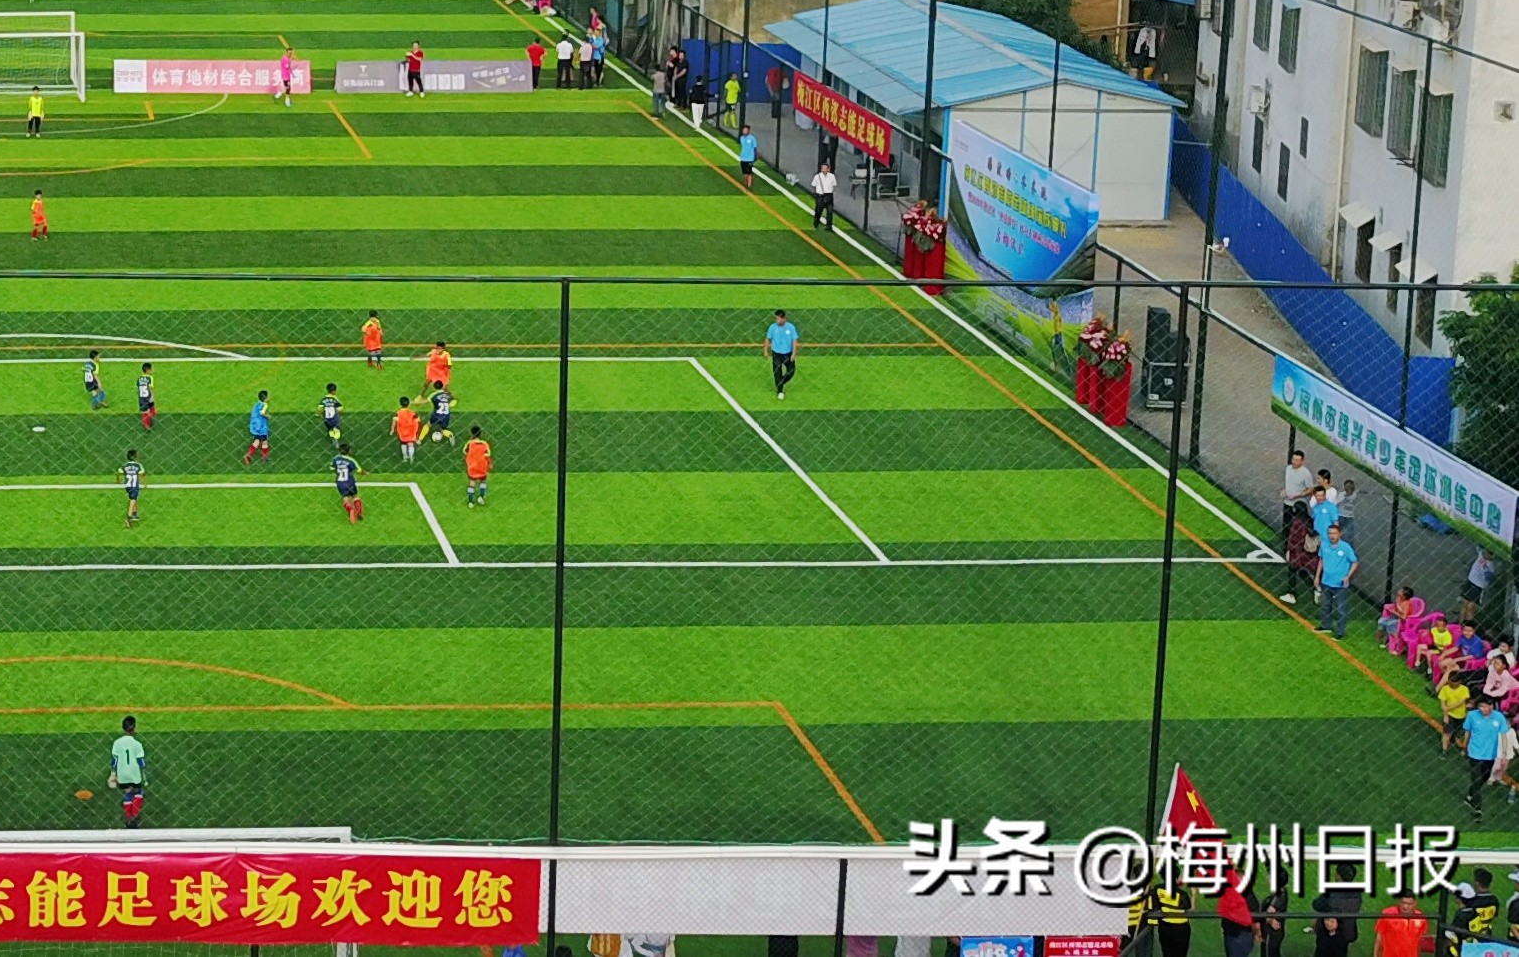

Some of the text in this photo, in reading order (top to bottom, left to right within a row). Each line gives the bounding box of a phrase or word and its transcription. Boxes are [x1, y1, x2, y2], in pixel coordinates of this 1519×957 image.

[796, 79, 886, 155] 梅江区西郊志能足球场
[125, 748, 131, 765] 1
